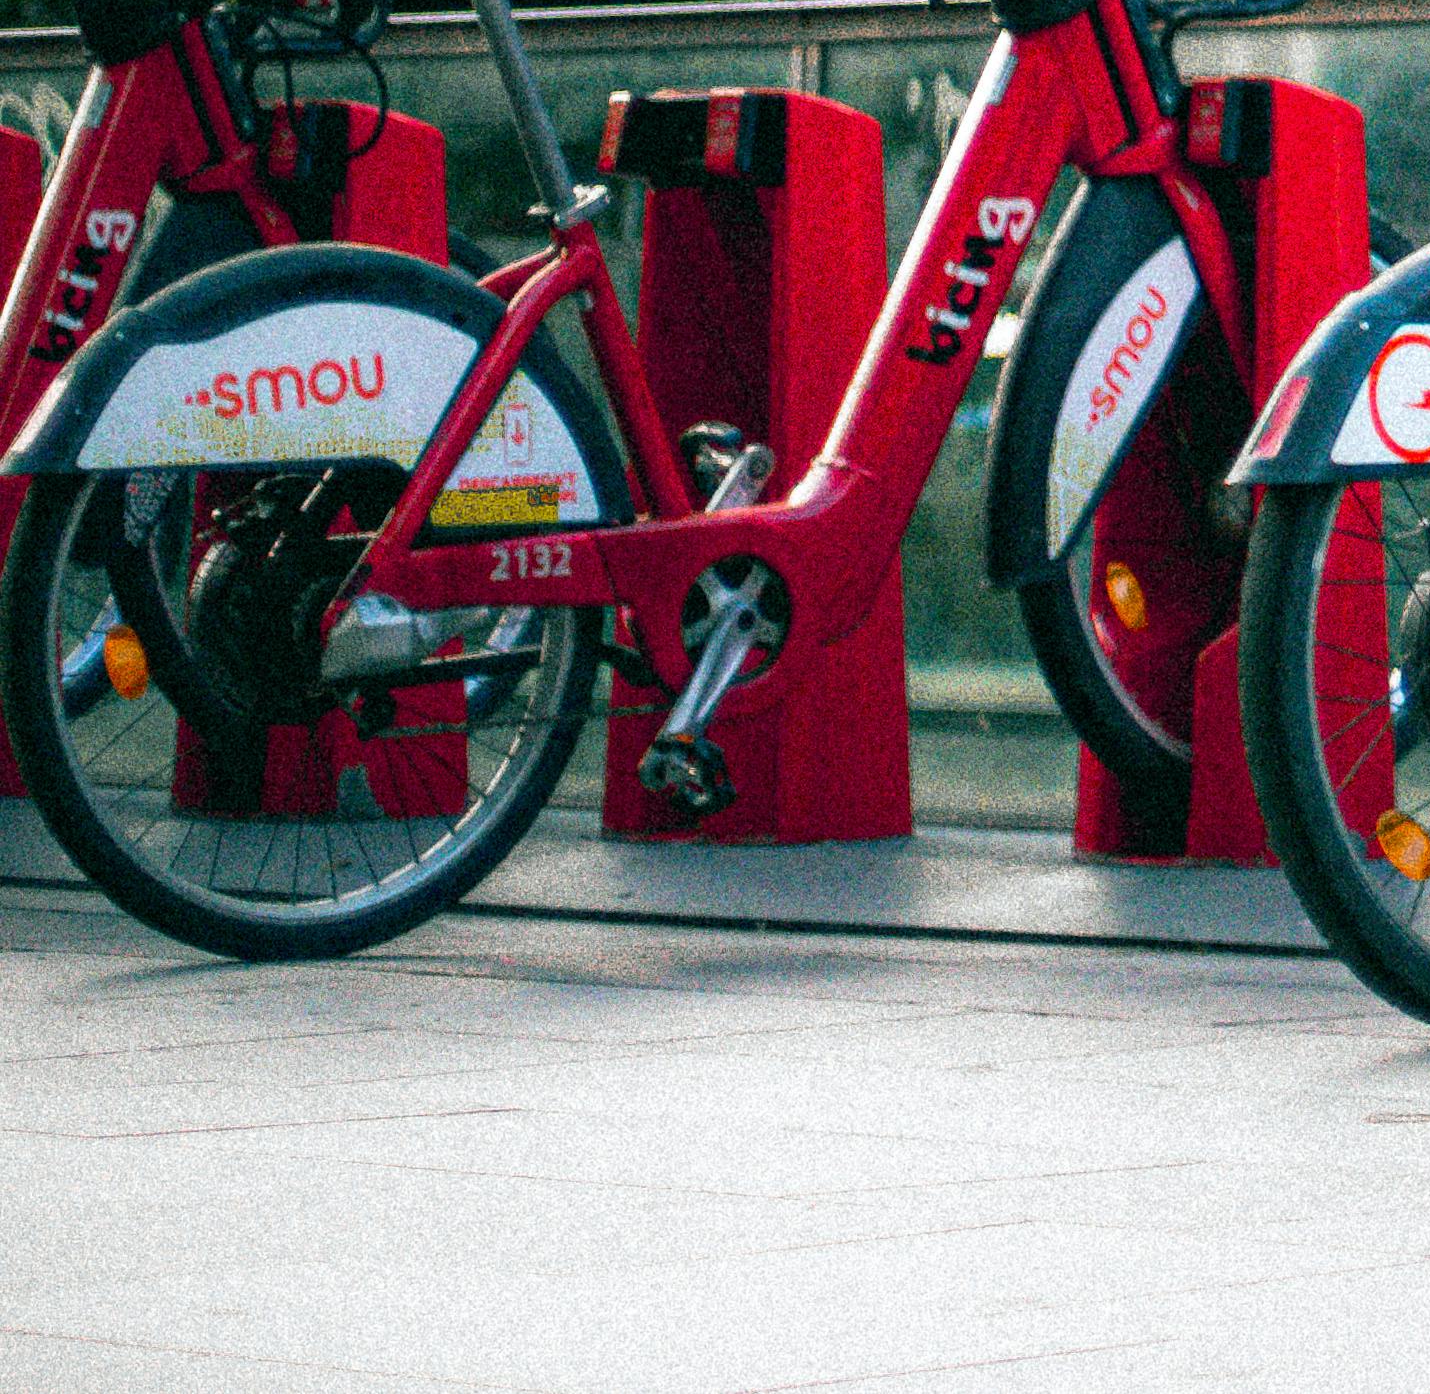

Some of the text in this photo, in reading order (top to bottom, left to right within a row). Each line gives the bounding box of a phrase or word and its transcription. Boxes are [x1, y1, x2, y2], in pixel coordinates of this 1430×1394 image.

[28, 209, 137, 365] bicing
[905, 196, 1035, 366] bicing
[489, 542, 573, 581] 2132
